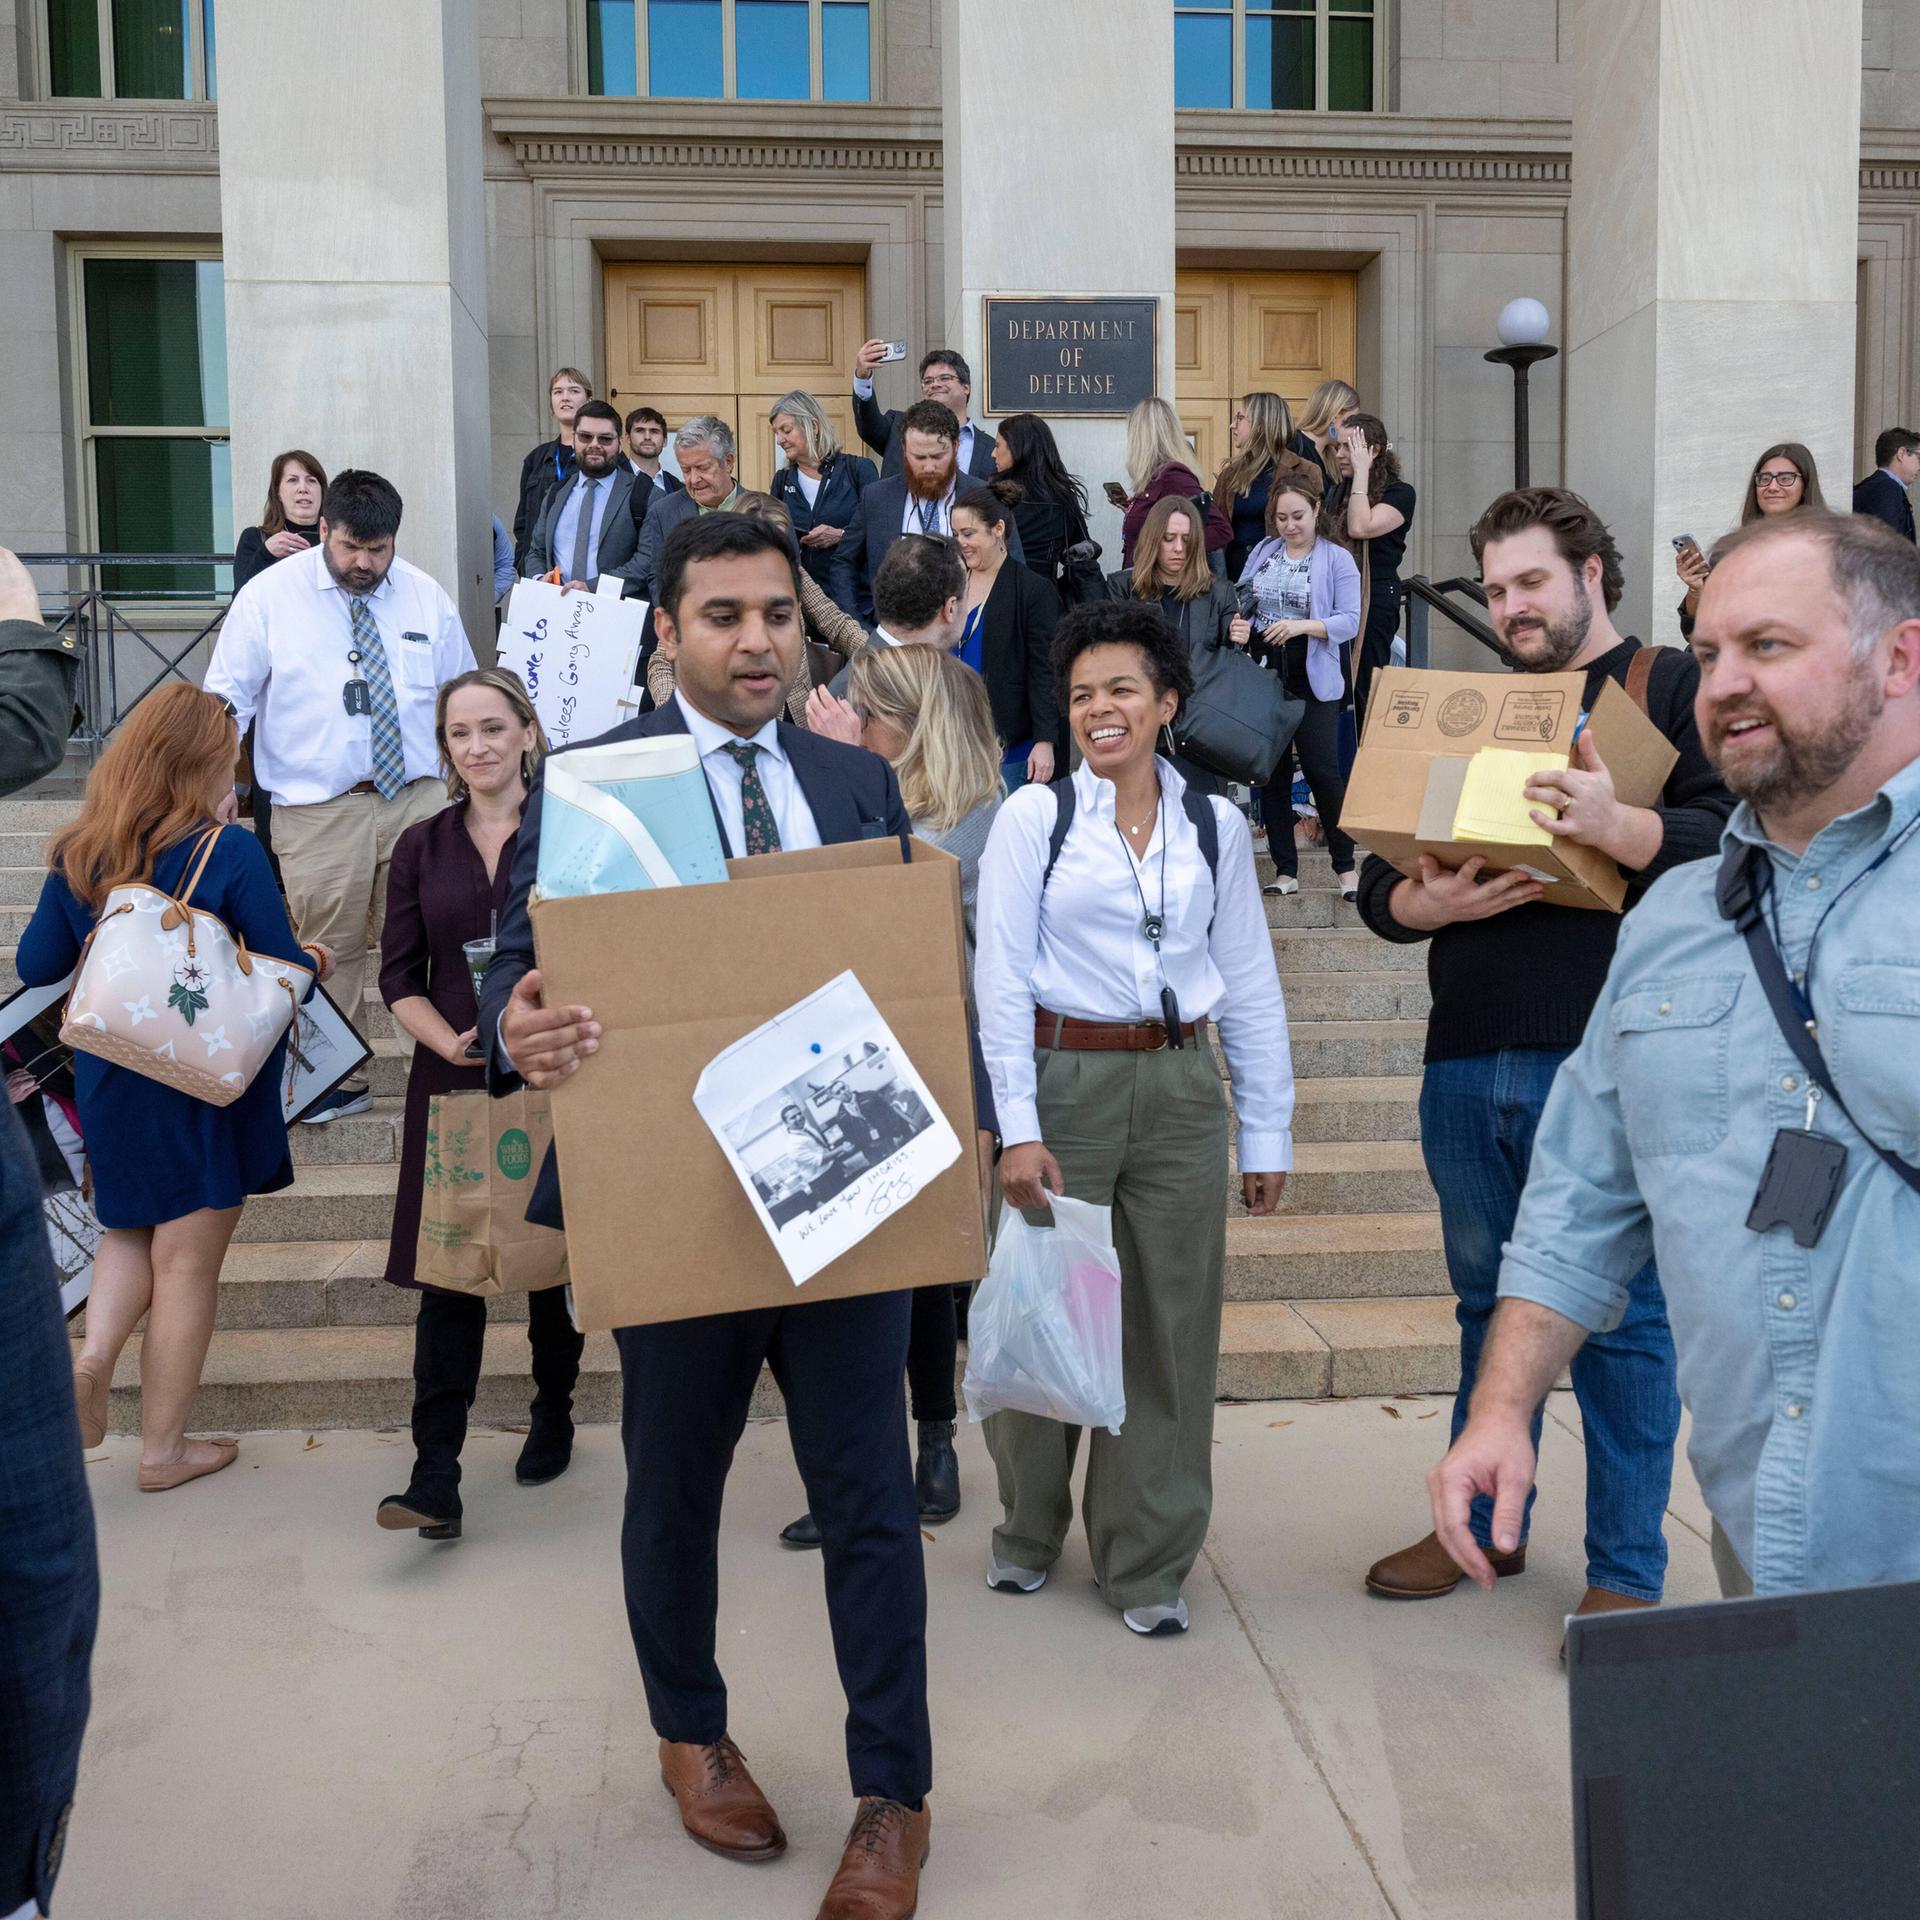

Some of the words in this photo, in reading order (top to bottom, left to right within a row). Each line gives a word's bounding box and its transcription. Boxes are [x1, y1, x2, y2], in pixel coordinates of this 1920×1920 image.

[1008, 319, 1136, 341] DEPARTMENT
[1060, 347, 1084, 368] OF
[1029, 374, 1116, 395] DEFENSE
[523, 617, 548, 643] to
[564, 600, 595, 640] Away
[558, 643, 591, 686] Going
[500, 1140, 530, 1154] WHOLE
[502, 1152, 530, 1165] FOODS
